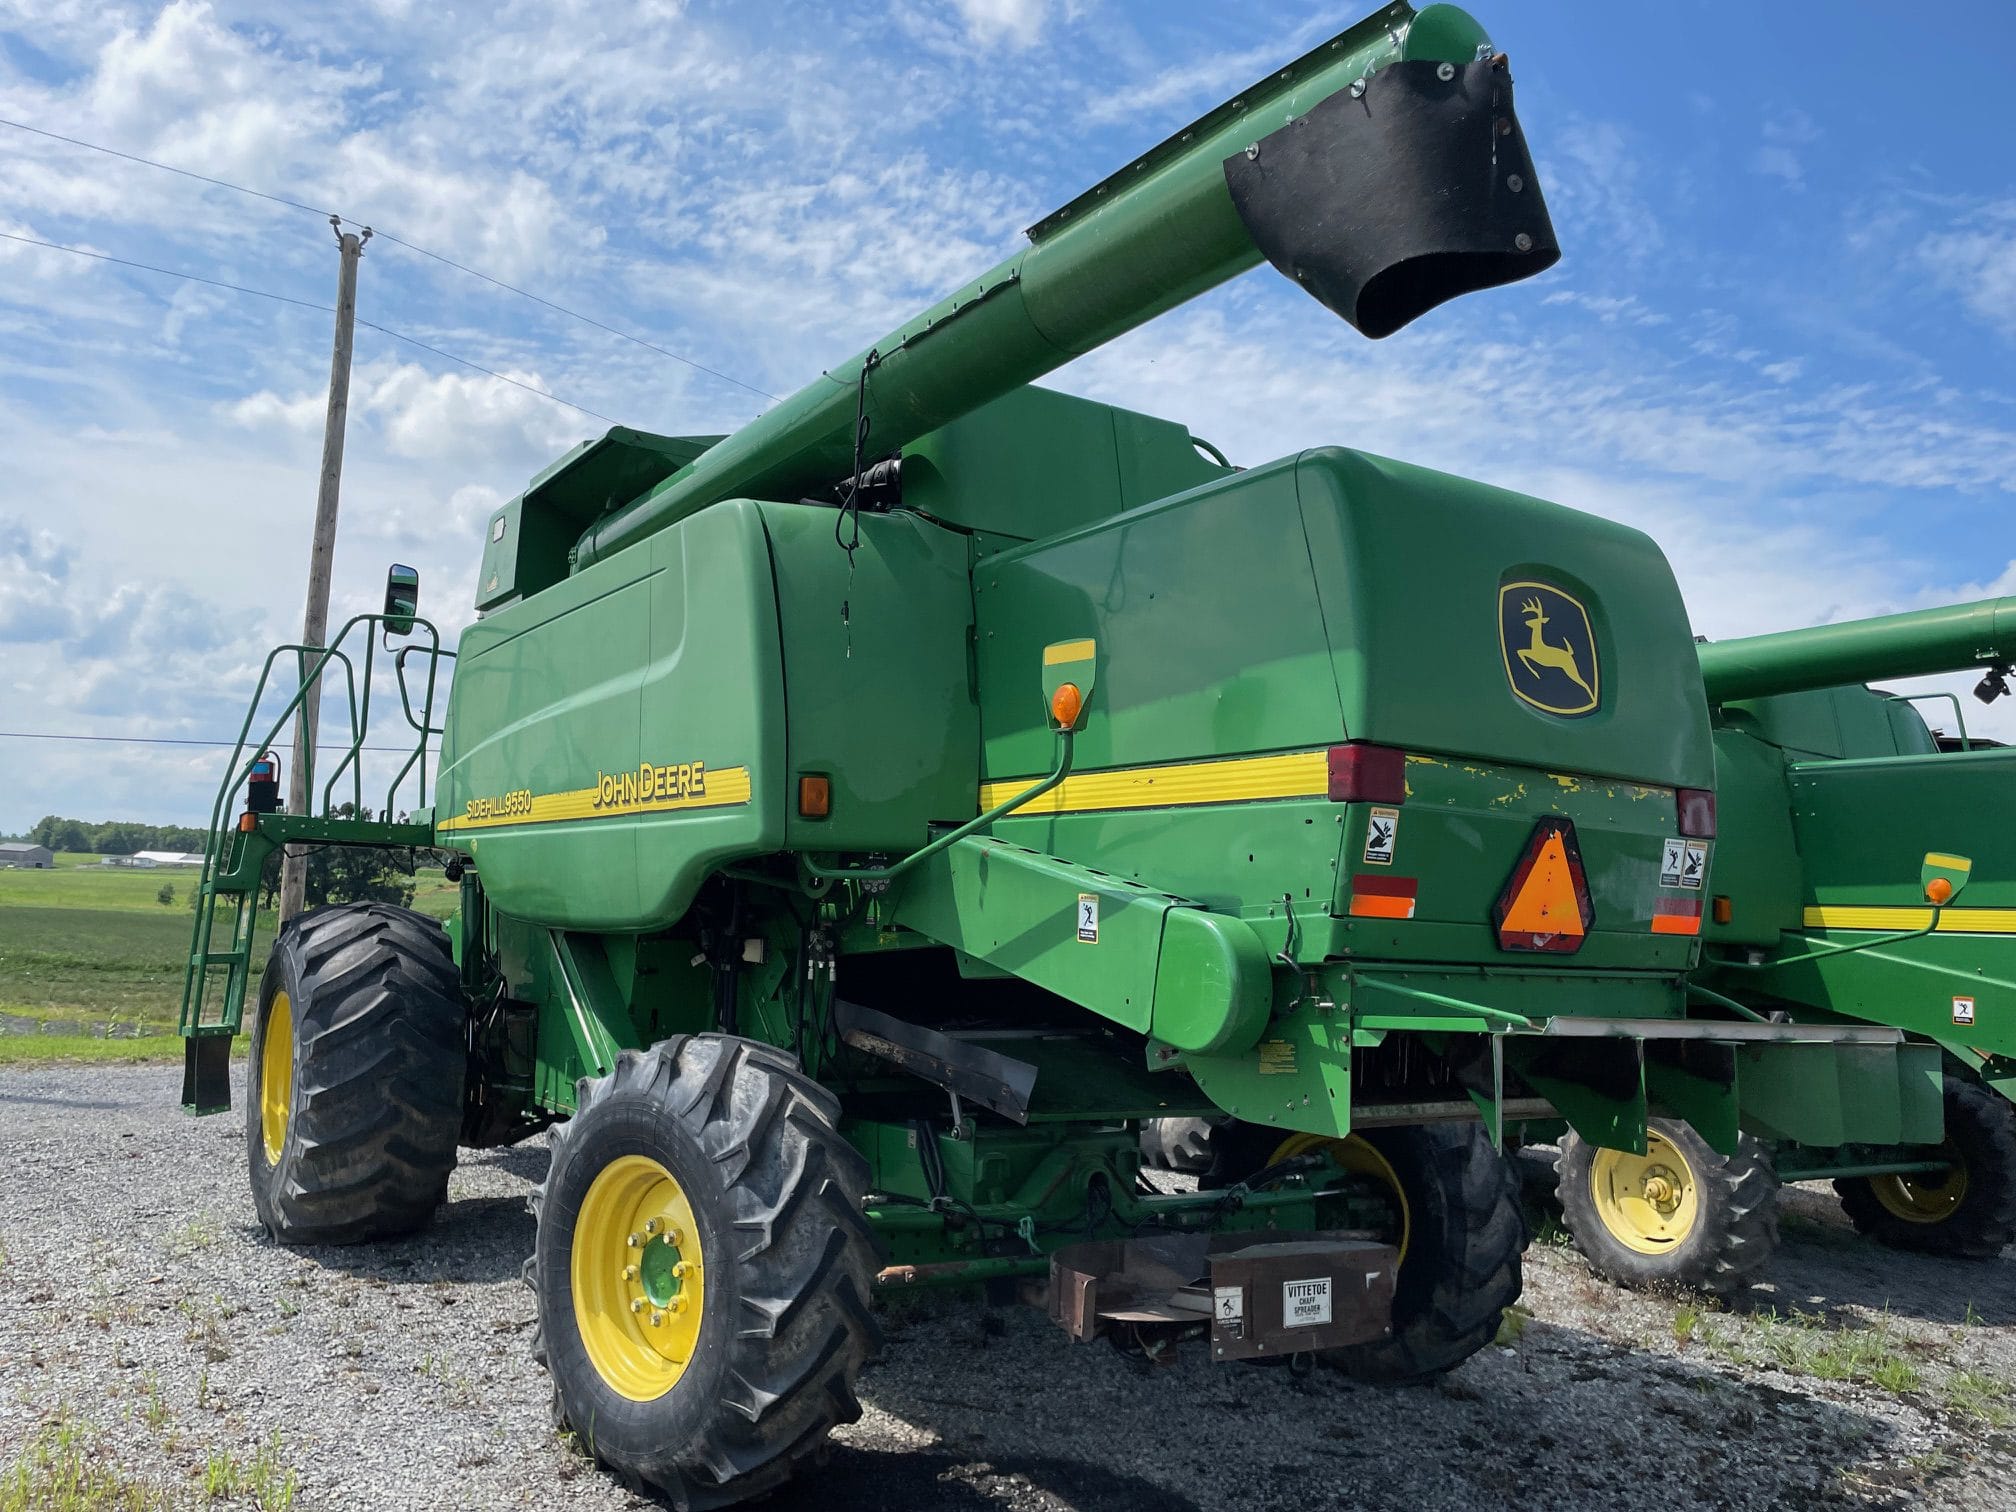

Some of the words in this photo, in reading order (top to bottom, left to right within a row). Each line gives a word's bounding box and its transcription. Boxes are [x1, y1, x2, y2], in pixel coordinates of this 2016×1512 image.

[592, 770, 638, 808] JOHN
[639, 760, 705, 801] DEERE
[505, 789, 532, 814] 9550
[1288, 1283, 1327, 1298] VITTETOE
